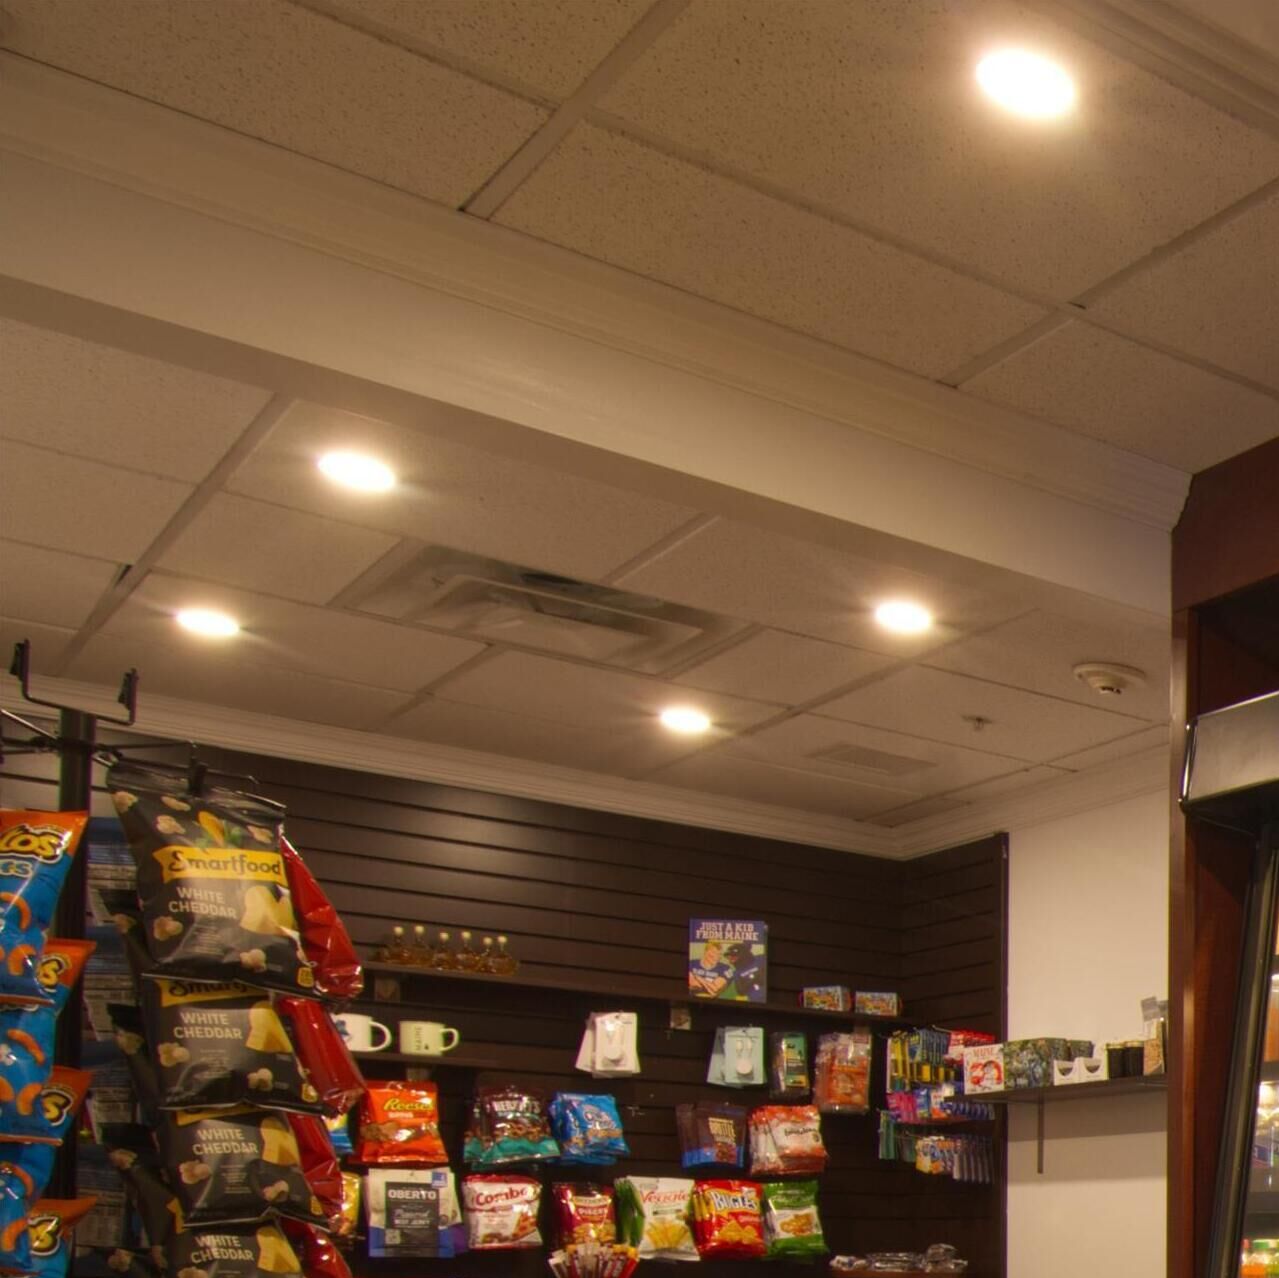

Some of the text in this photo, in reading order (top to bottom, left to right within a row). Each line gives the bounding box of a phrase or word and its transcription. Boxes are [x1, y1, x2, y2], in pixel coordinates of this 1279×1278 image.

[168, 850, 282, 875] Smartfood
[176, 887, 226, 905] WHITE
[168, 901, 238, 919] CHEDDAR
[700, 922, 754, 932] JUST A KID
[696, 930, 759, 941] FROM MAINE
[180, 1012, 230, 1025] WHITE
[173, 1026, 243, 1040] CHEDDAR
[197, 1129, 245, 1141] WHITE
[192, 1142, 259, 1155] CHEDDAR
[388, 1188, 437, 1201] OBERTO
[195, 1234, 242, 1248] WHITE
[191, 1247, 255, 1264] CHEDDAR
